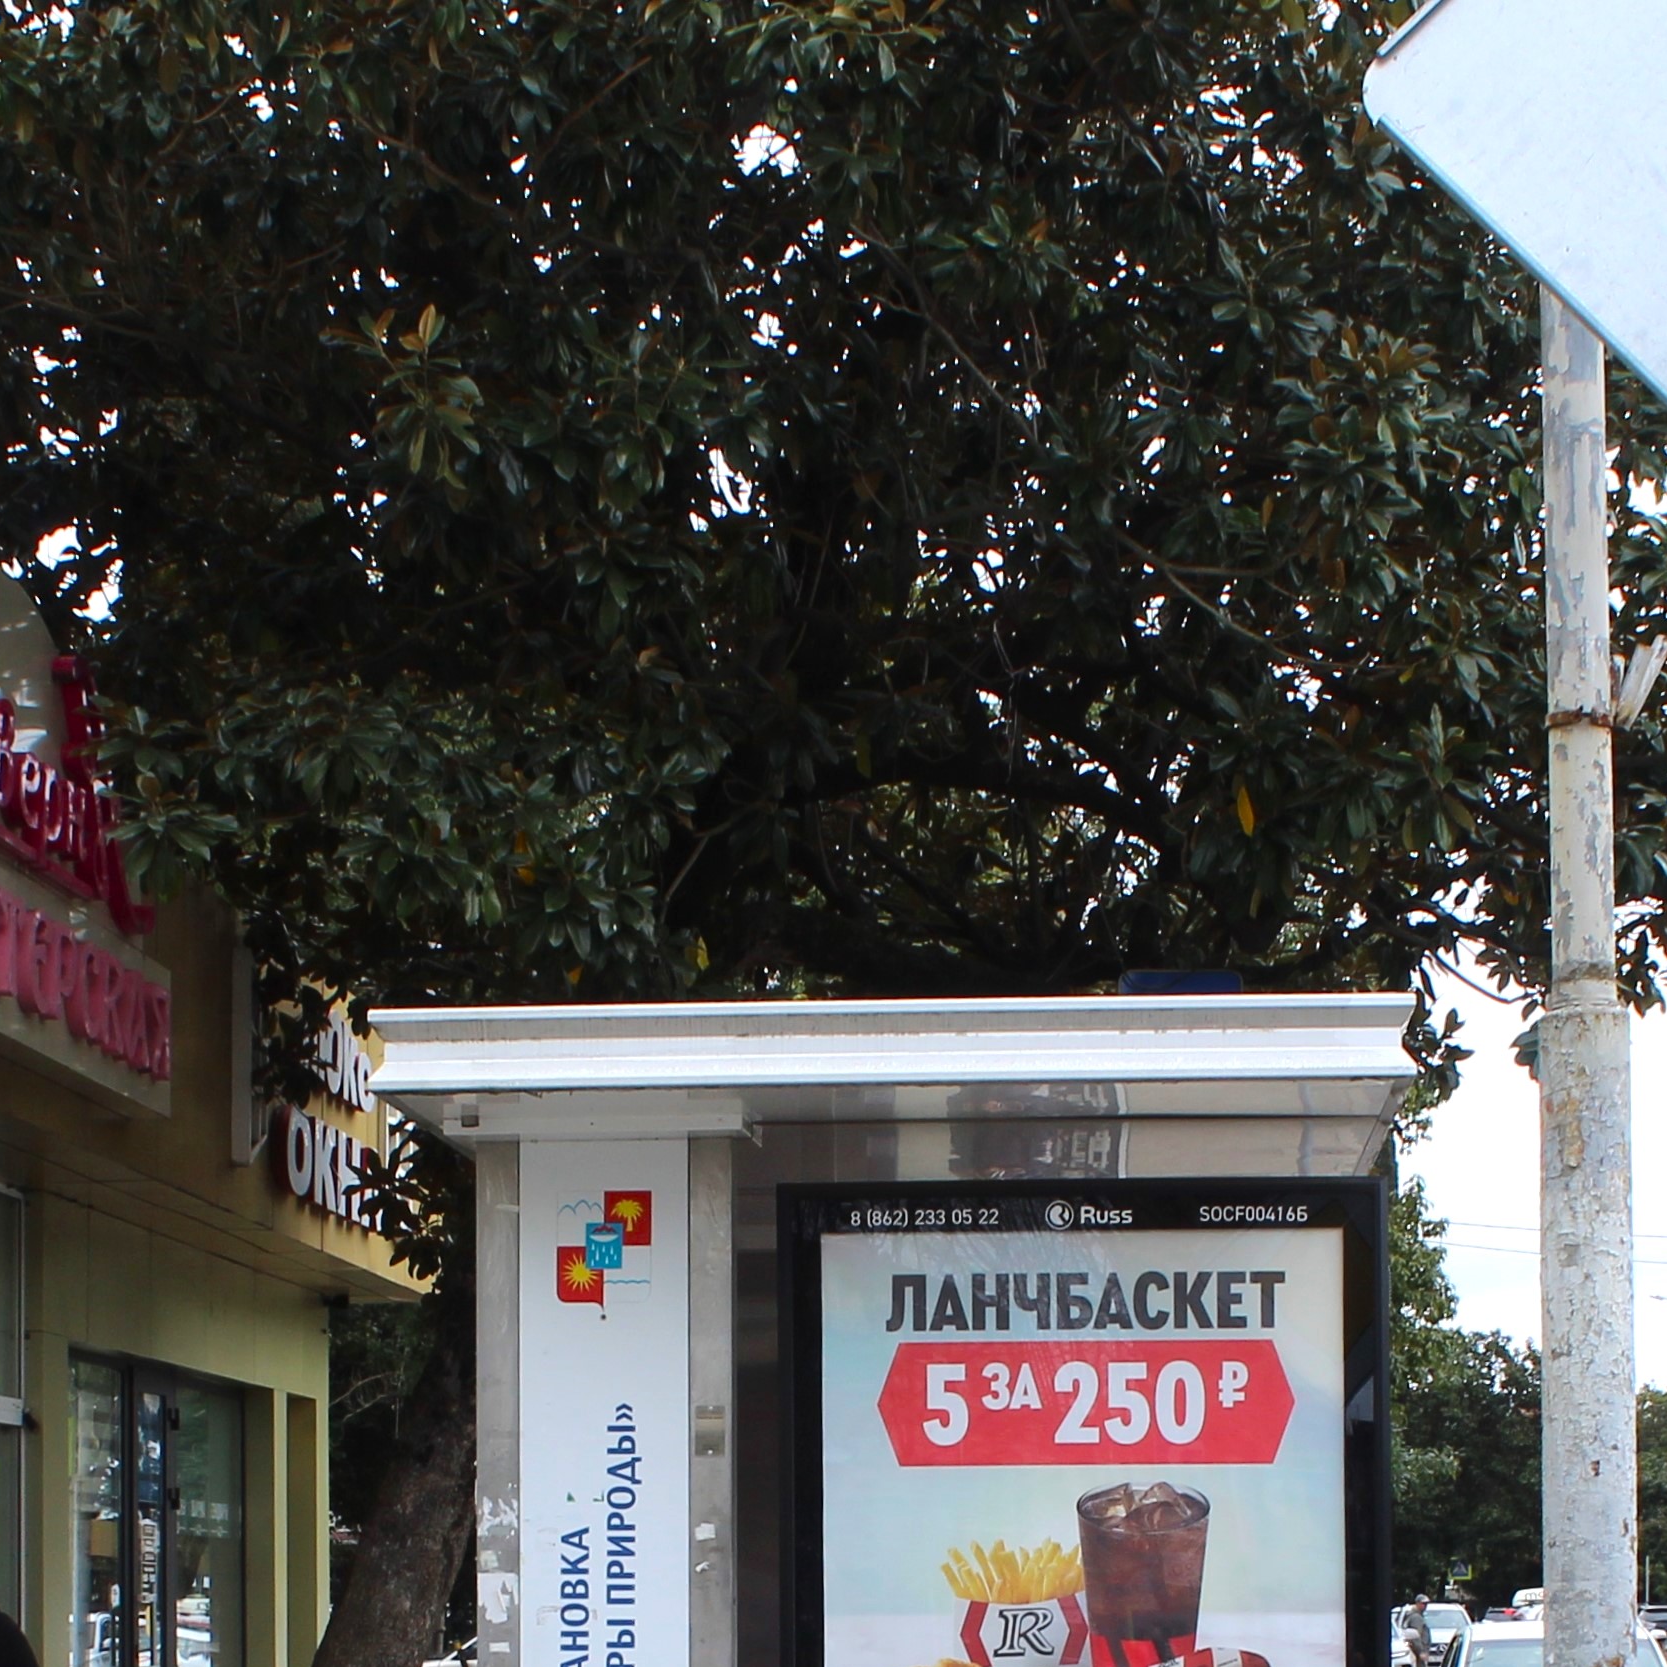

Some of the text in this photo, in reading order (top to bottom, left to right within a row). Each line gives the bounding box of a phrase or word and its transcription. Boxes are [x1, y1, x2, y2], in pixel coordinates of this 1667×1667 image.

[850, 1208, 1000, 1229] 8 (862) 233 05 22
[1079, 1207, 1133, 1225] Russ
[885, 1270, 1285, 1332] ЛАНЧБАСКЕТ
[922, 1363, 970, 1446] 5
[981, 1362, 1042, 1410] ЗА
[1053, 1361, 1206, 1445] 250
[605, 1402, 643, 1605] ПРИРОДЫ»
